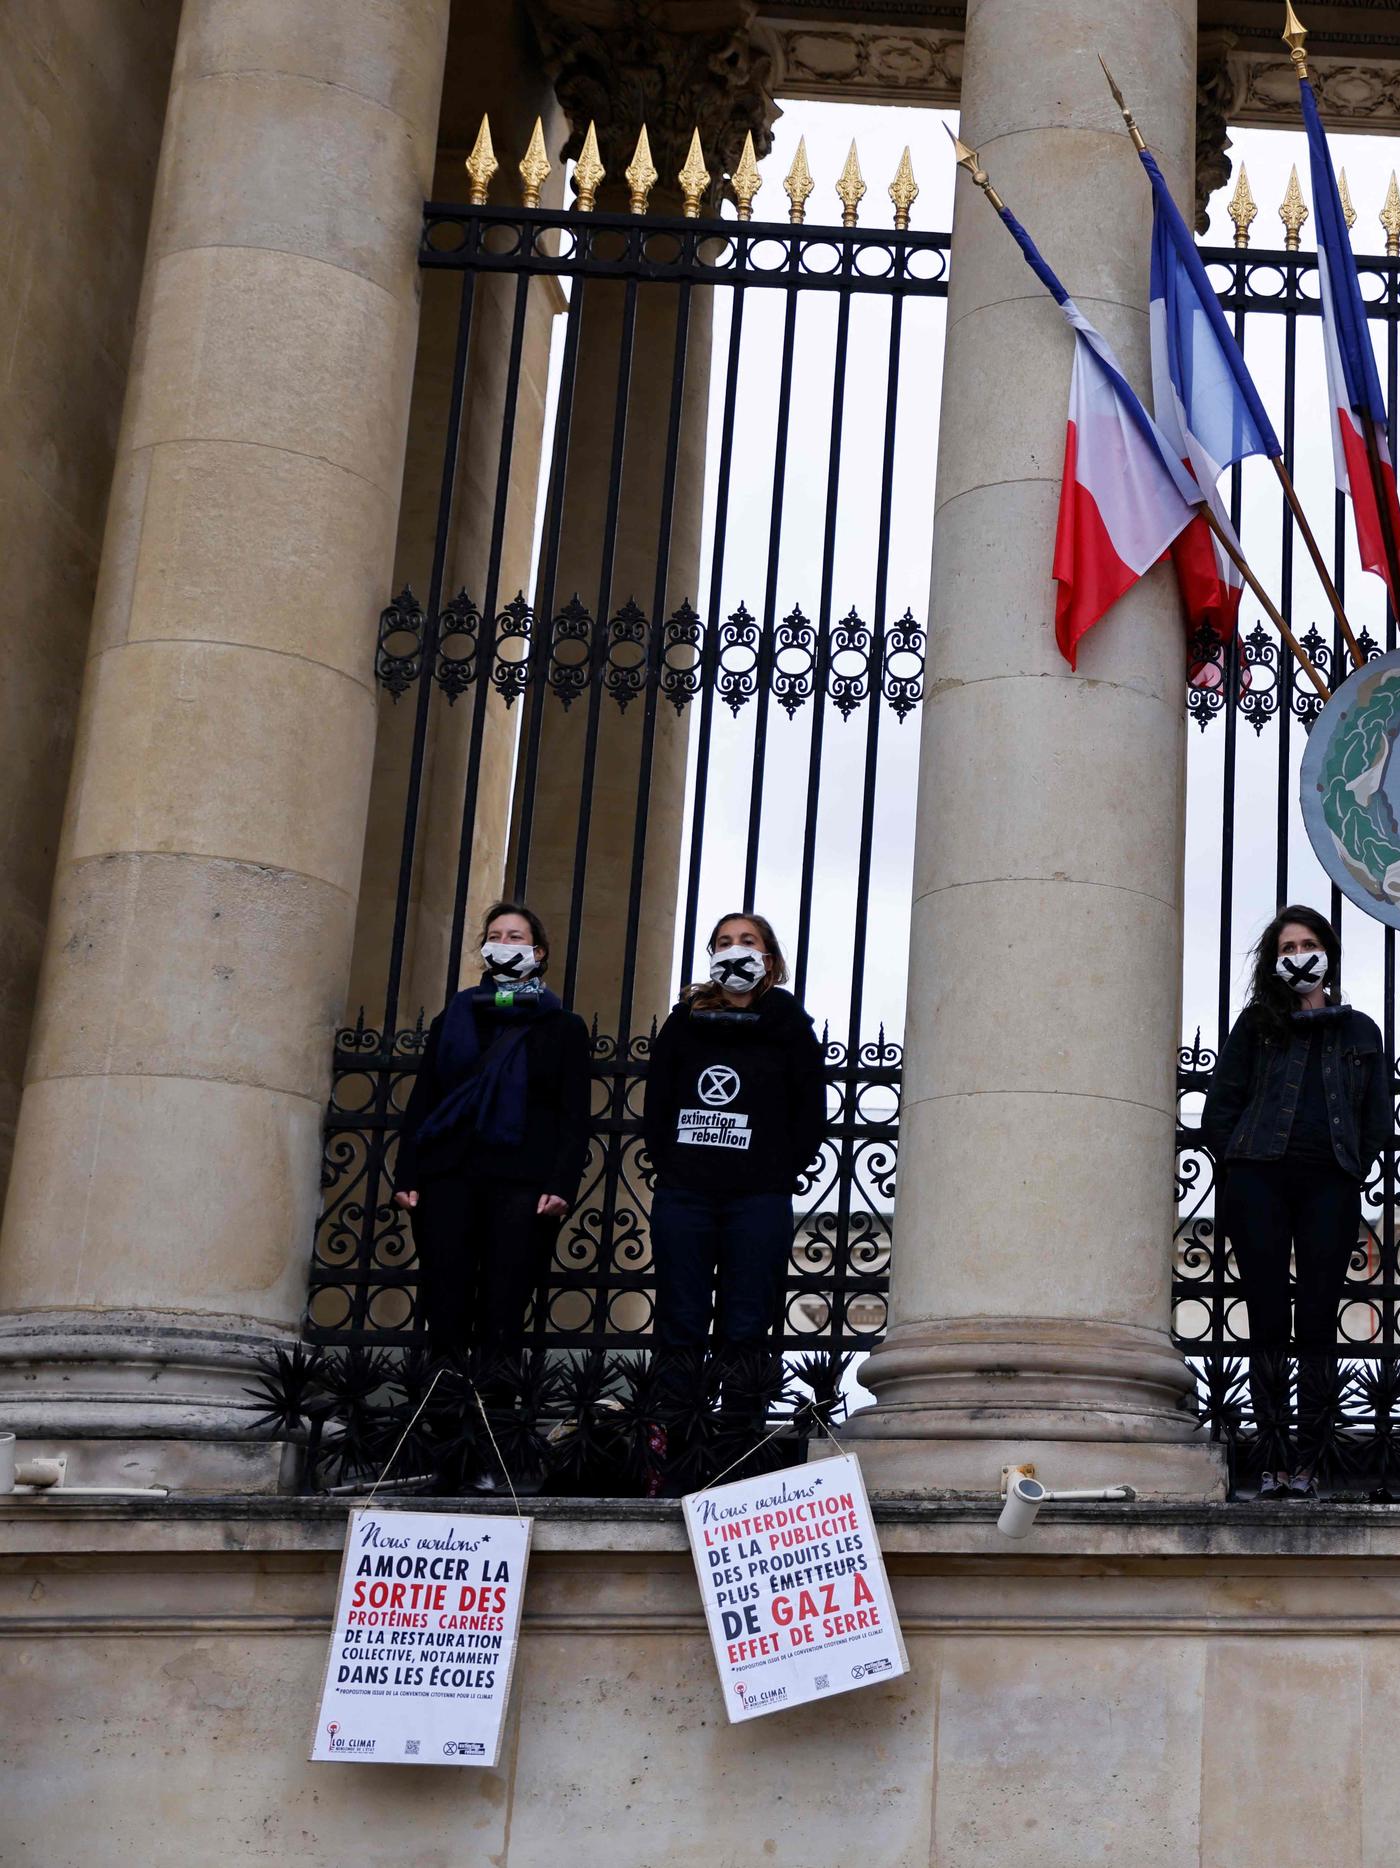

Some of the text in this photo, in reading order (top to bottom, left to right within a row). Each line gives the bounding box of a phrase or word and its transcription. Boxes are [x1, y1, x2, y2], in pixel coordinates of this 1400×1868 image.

[681, 1111, 736, 1128] extinction
[692, 1127, 747, 1147] rebellion
[697, 1500, 748, 1524] Nous
[704, 1493, 855, 1547] L'INTERDICTION
[360, 1522, 410, 1548] Nous
[708, 1511, 859, 1568] DE LA PUBLICITÉ
[357, 1555, 510, 1583] AMORCER LA
[712, 1534, 864, 1588] DES PRODUITS LES
[717, 1554, 868, 1608] PLUS ÉMETTEURS
[352, 1581, 507, 1613] SORTIE DES
[721, 1572, 875, 1641] DE GAZ À
[348, 1610, 504, 1632] PROTÉINES CARNÉES
[345, 1630, 502, 1649] DE LA RESTAURATION
[727, 1606, 881, 1665] EFFET DE SERRE
[342, 1648, 499, 1665] COLLECTIVE, NOTAMMENT
[337, 1665, 495, 1689] DANS LES ÉCOLES
[744, 1687, 786, 1704] LOI CLIMAT
[332, 1739, 376, 1748] LOI CLIMAT
